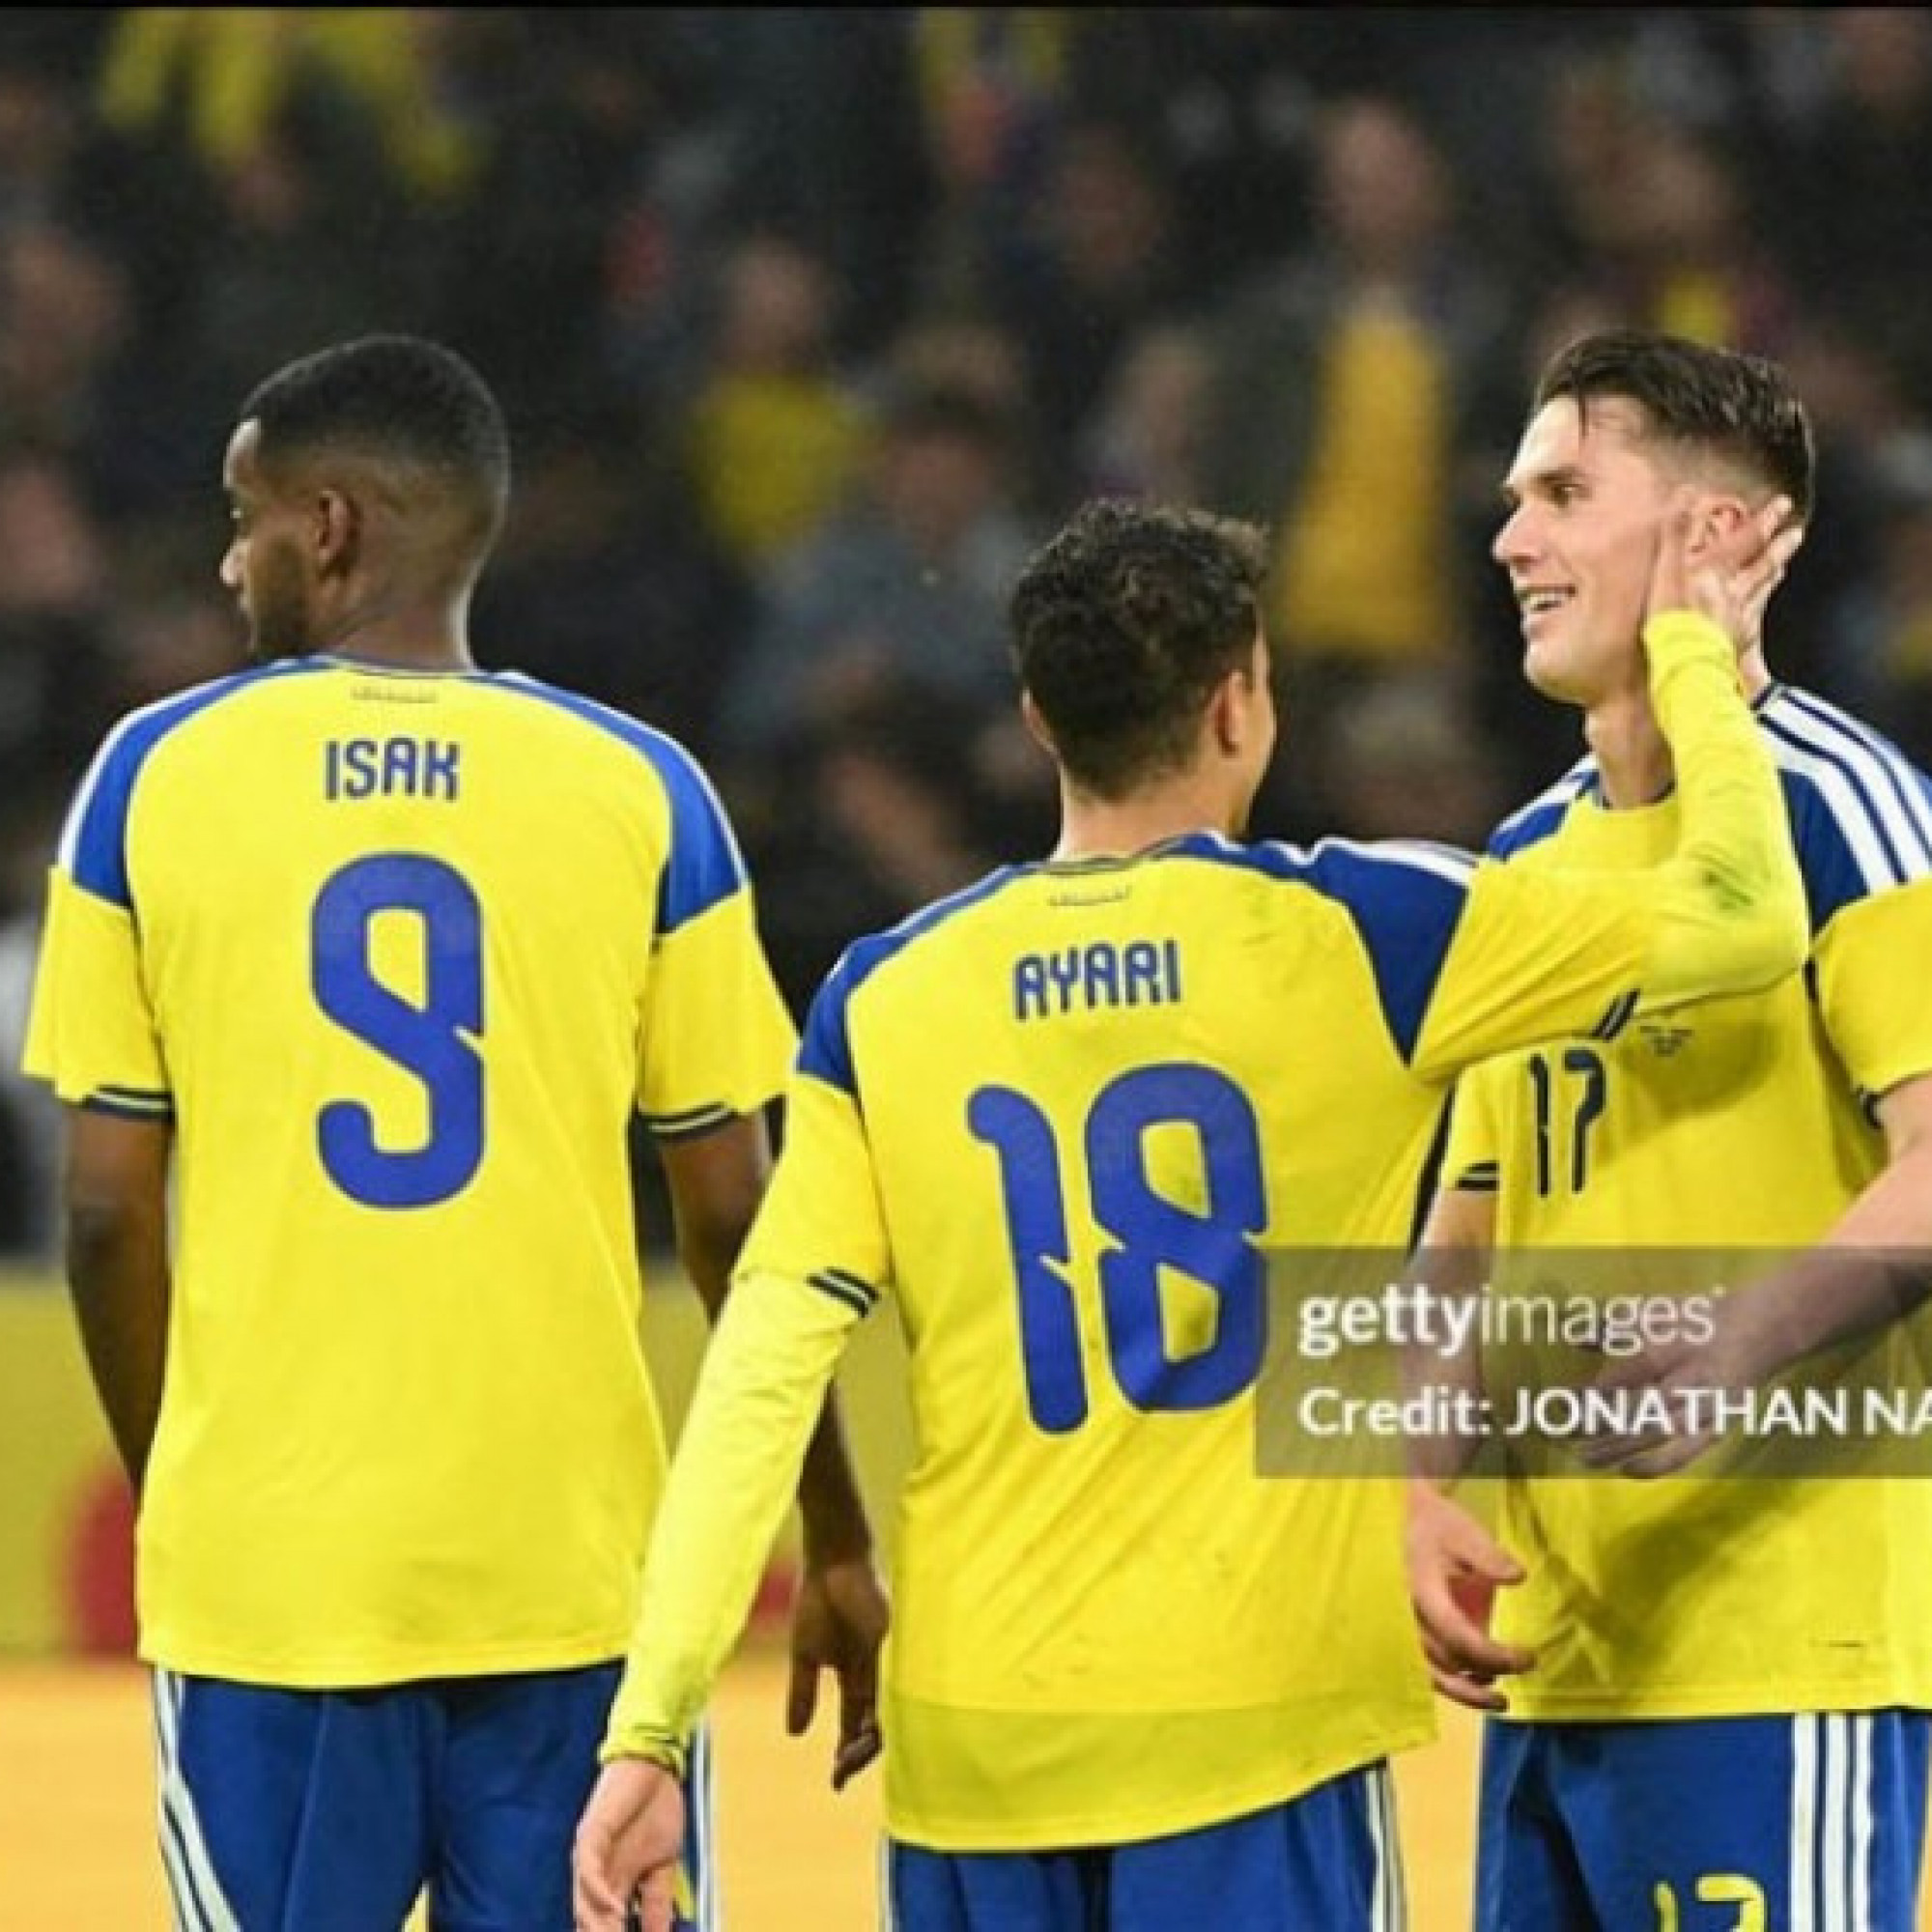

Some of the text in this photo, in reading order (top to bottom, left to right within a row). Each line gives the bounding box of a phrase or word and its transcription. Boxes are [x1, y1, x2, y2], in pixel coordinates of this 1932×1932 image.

[324, 737, 461, 802] ISAK
[310, 851, 487, 1209] 9
[1013, 937, 1181, 1023] AYARI
[1527, 1047, 1607, 1198] 17
[964, 1062, 1269, 1435] 18
